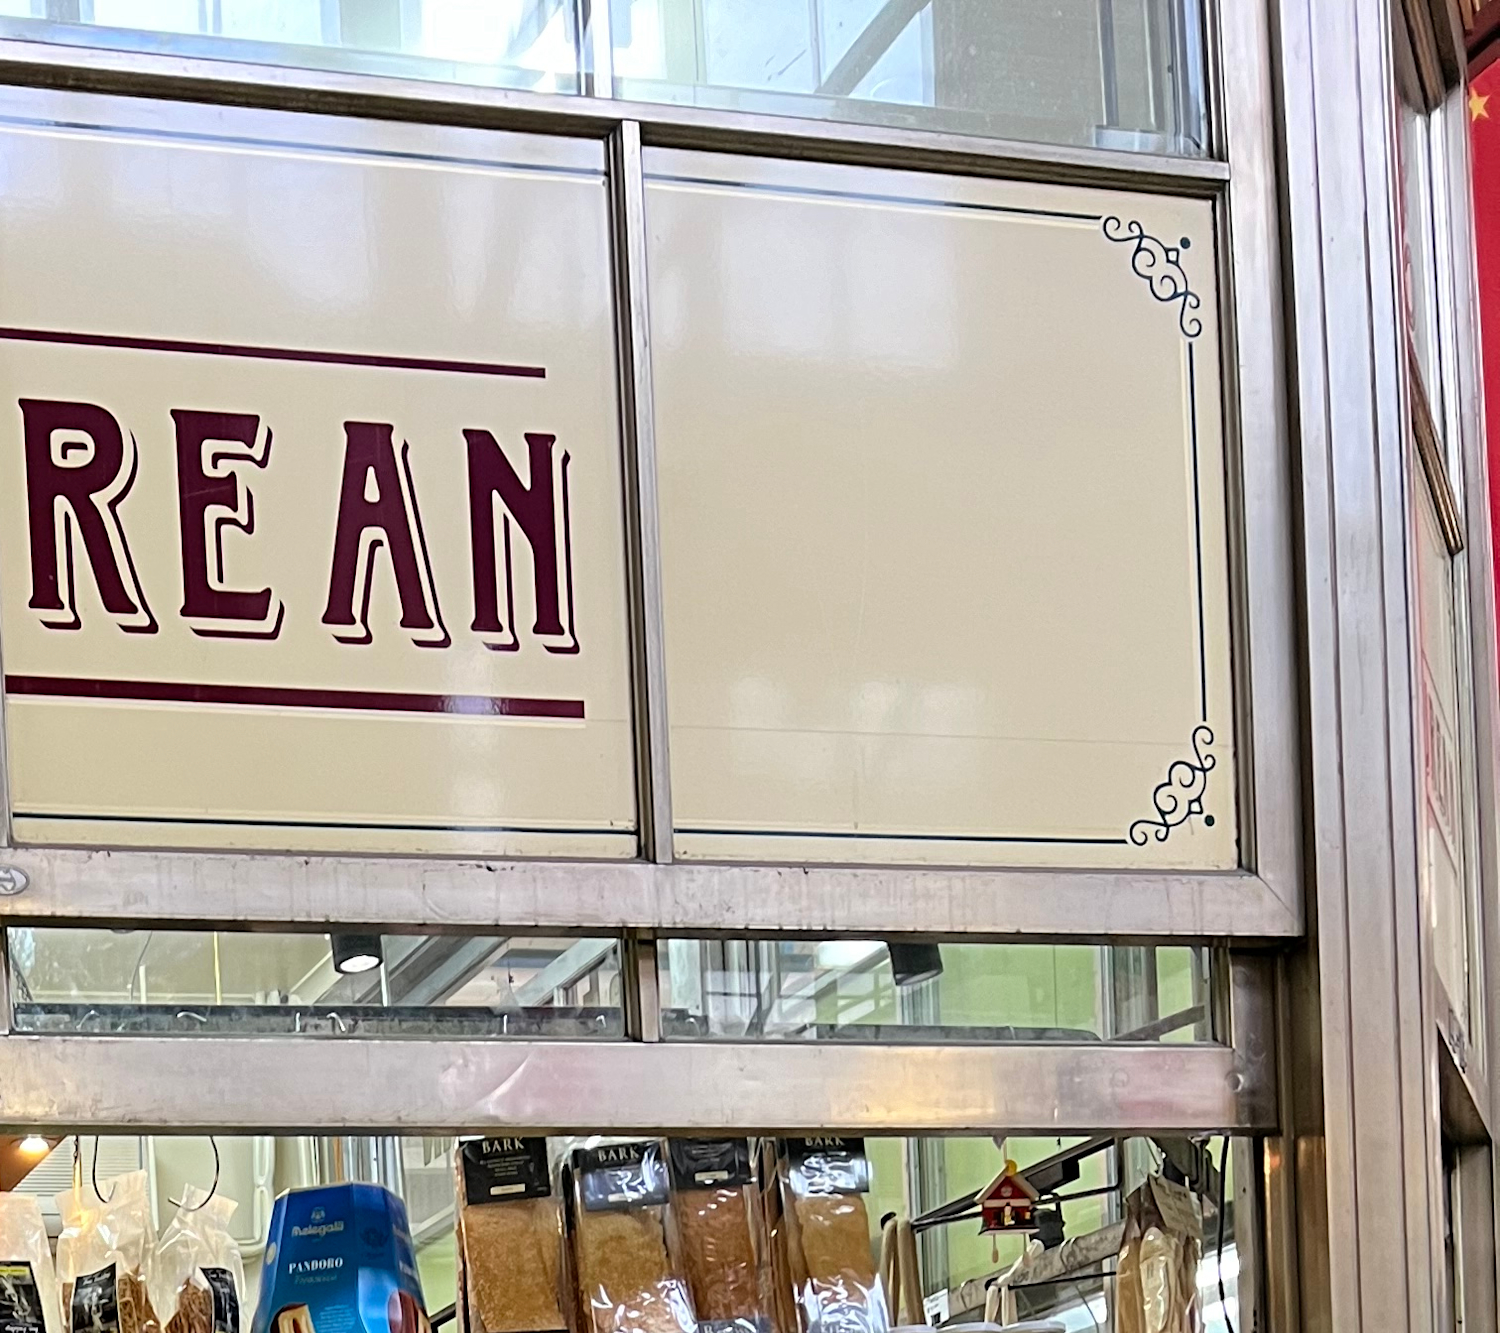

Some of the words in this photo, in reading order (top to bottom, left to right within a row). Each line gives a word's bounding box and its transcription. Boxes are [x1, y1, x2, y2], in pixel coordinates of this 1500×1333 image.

[482, 1137, 525, 1154] BARK
[598, 1146, 640, 1162] BARK
[288, 1257, 343, 1274] PANDORO
